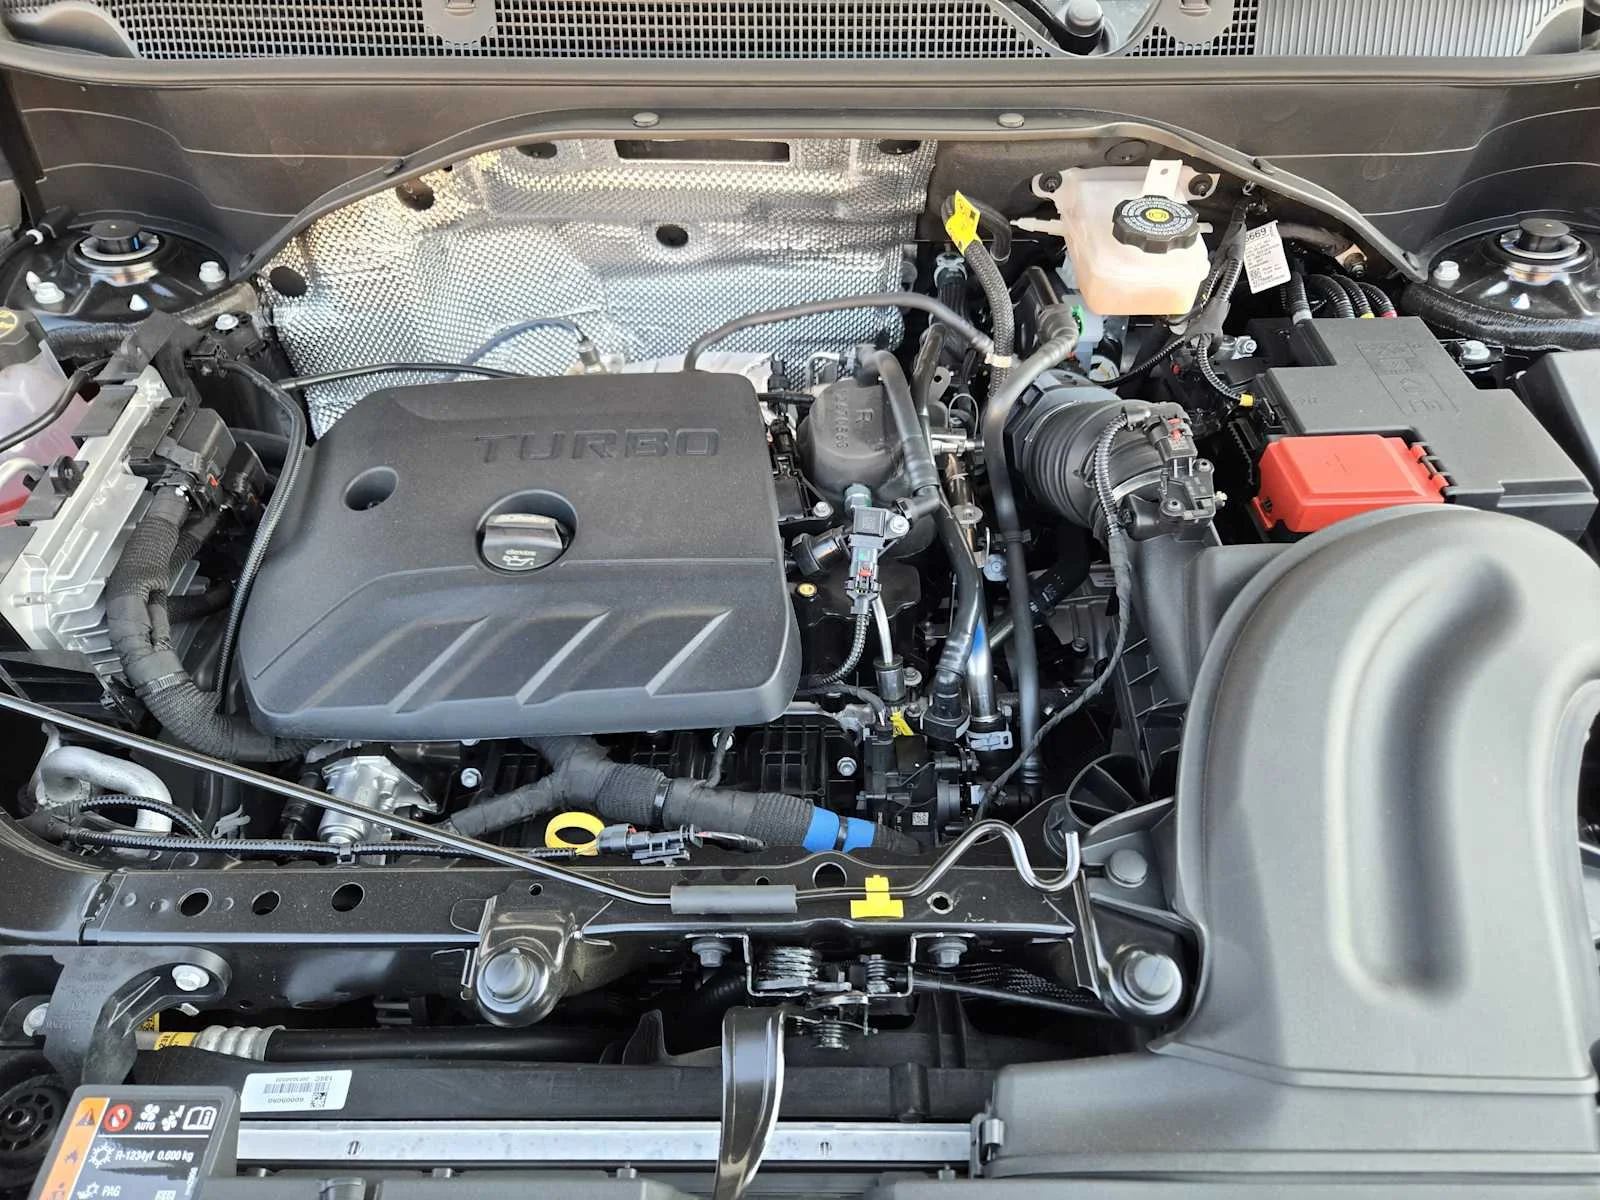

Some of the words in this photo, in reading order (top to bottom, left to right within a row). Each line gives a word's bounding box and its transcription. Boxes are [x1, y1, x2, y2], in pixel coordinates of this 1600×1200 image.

[855, 408, 874, 424] R
[473, 428, 720, 463] TURBO
[134, 1122, 156, 1131] AUTO
[102, 1185, 121, 1197] PAG
